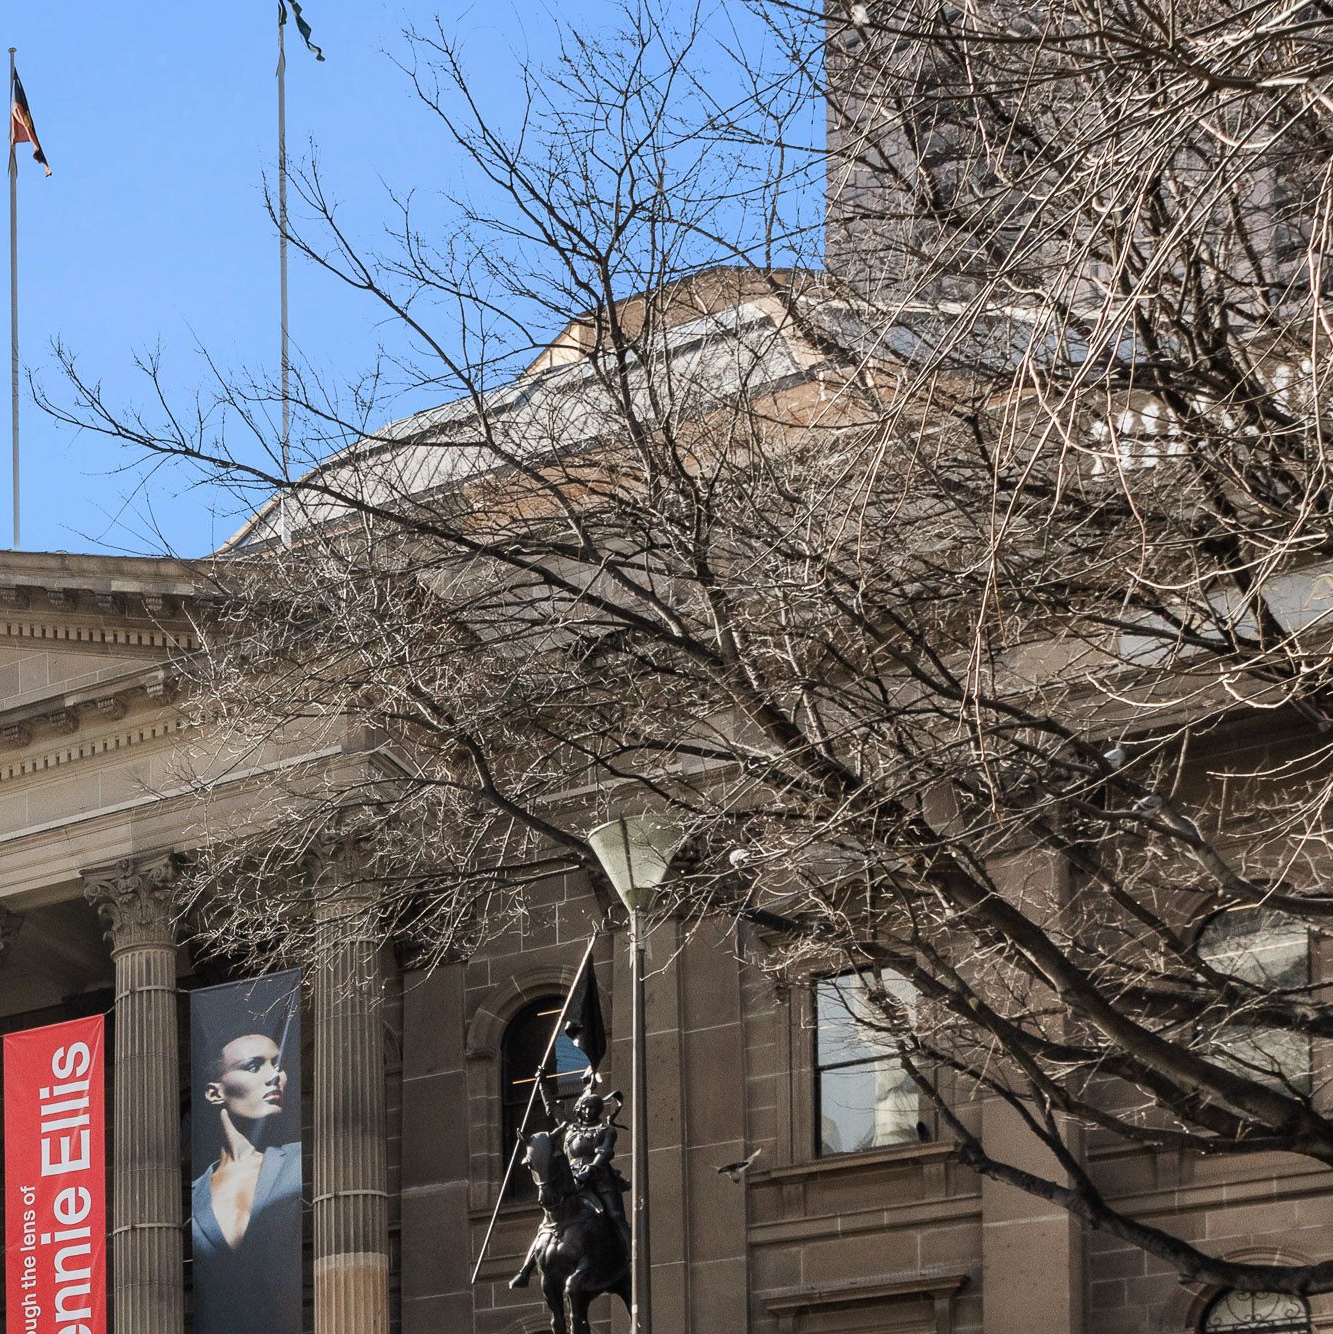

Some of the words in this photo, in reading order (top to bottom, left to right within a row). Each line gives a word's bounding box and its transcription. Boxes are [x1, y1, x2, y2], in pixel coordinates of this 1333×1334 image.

[39, 1041, 91, 1178] Ellis
[20, 1185, 36, 1207] of
[20, 1209, 36, 1252] lens
[20, 1255, 37, 1290] the
